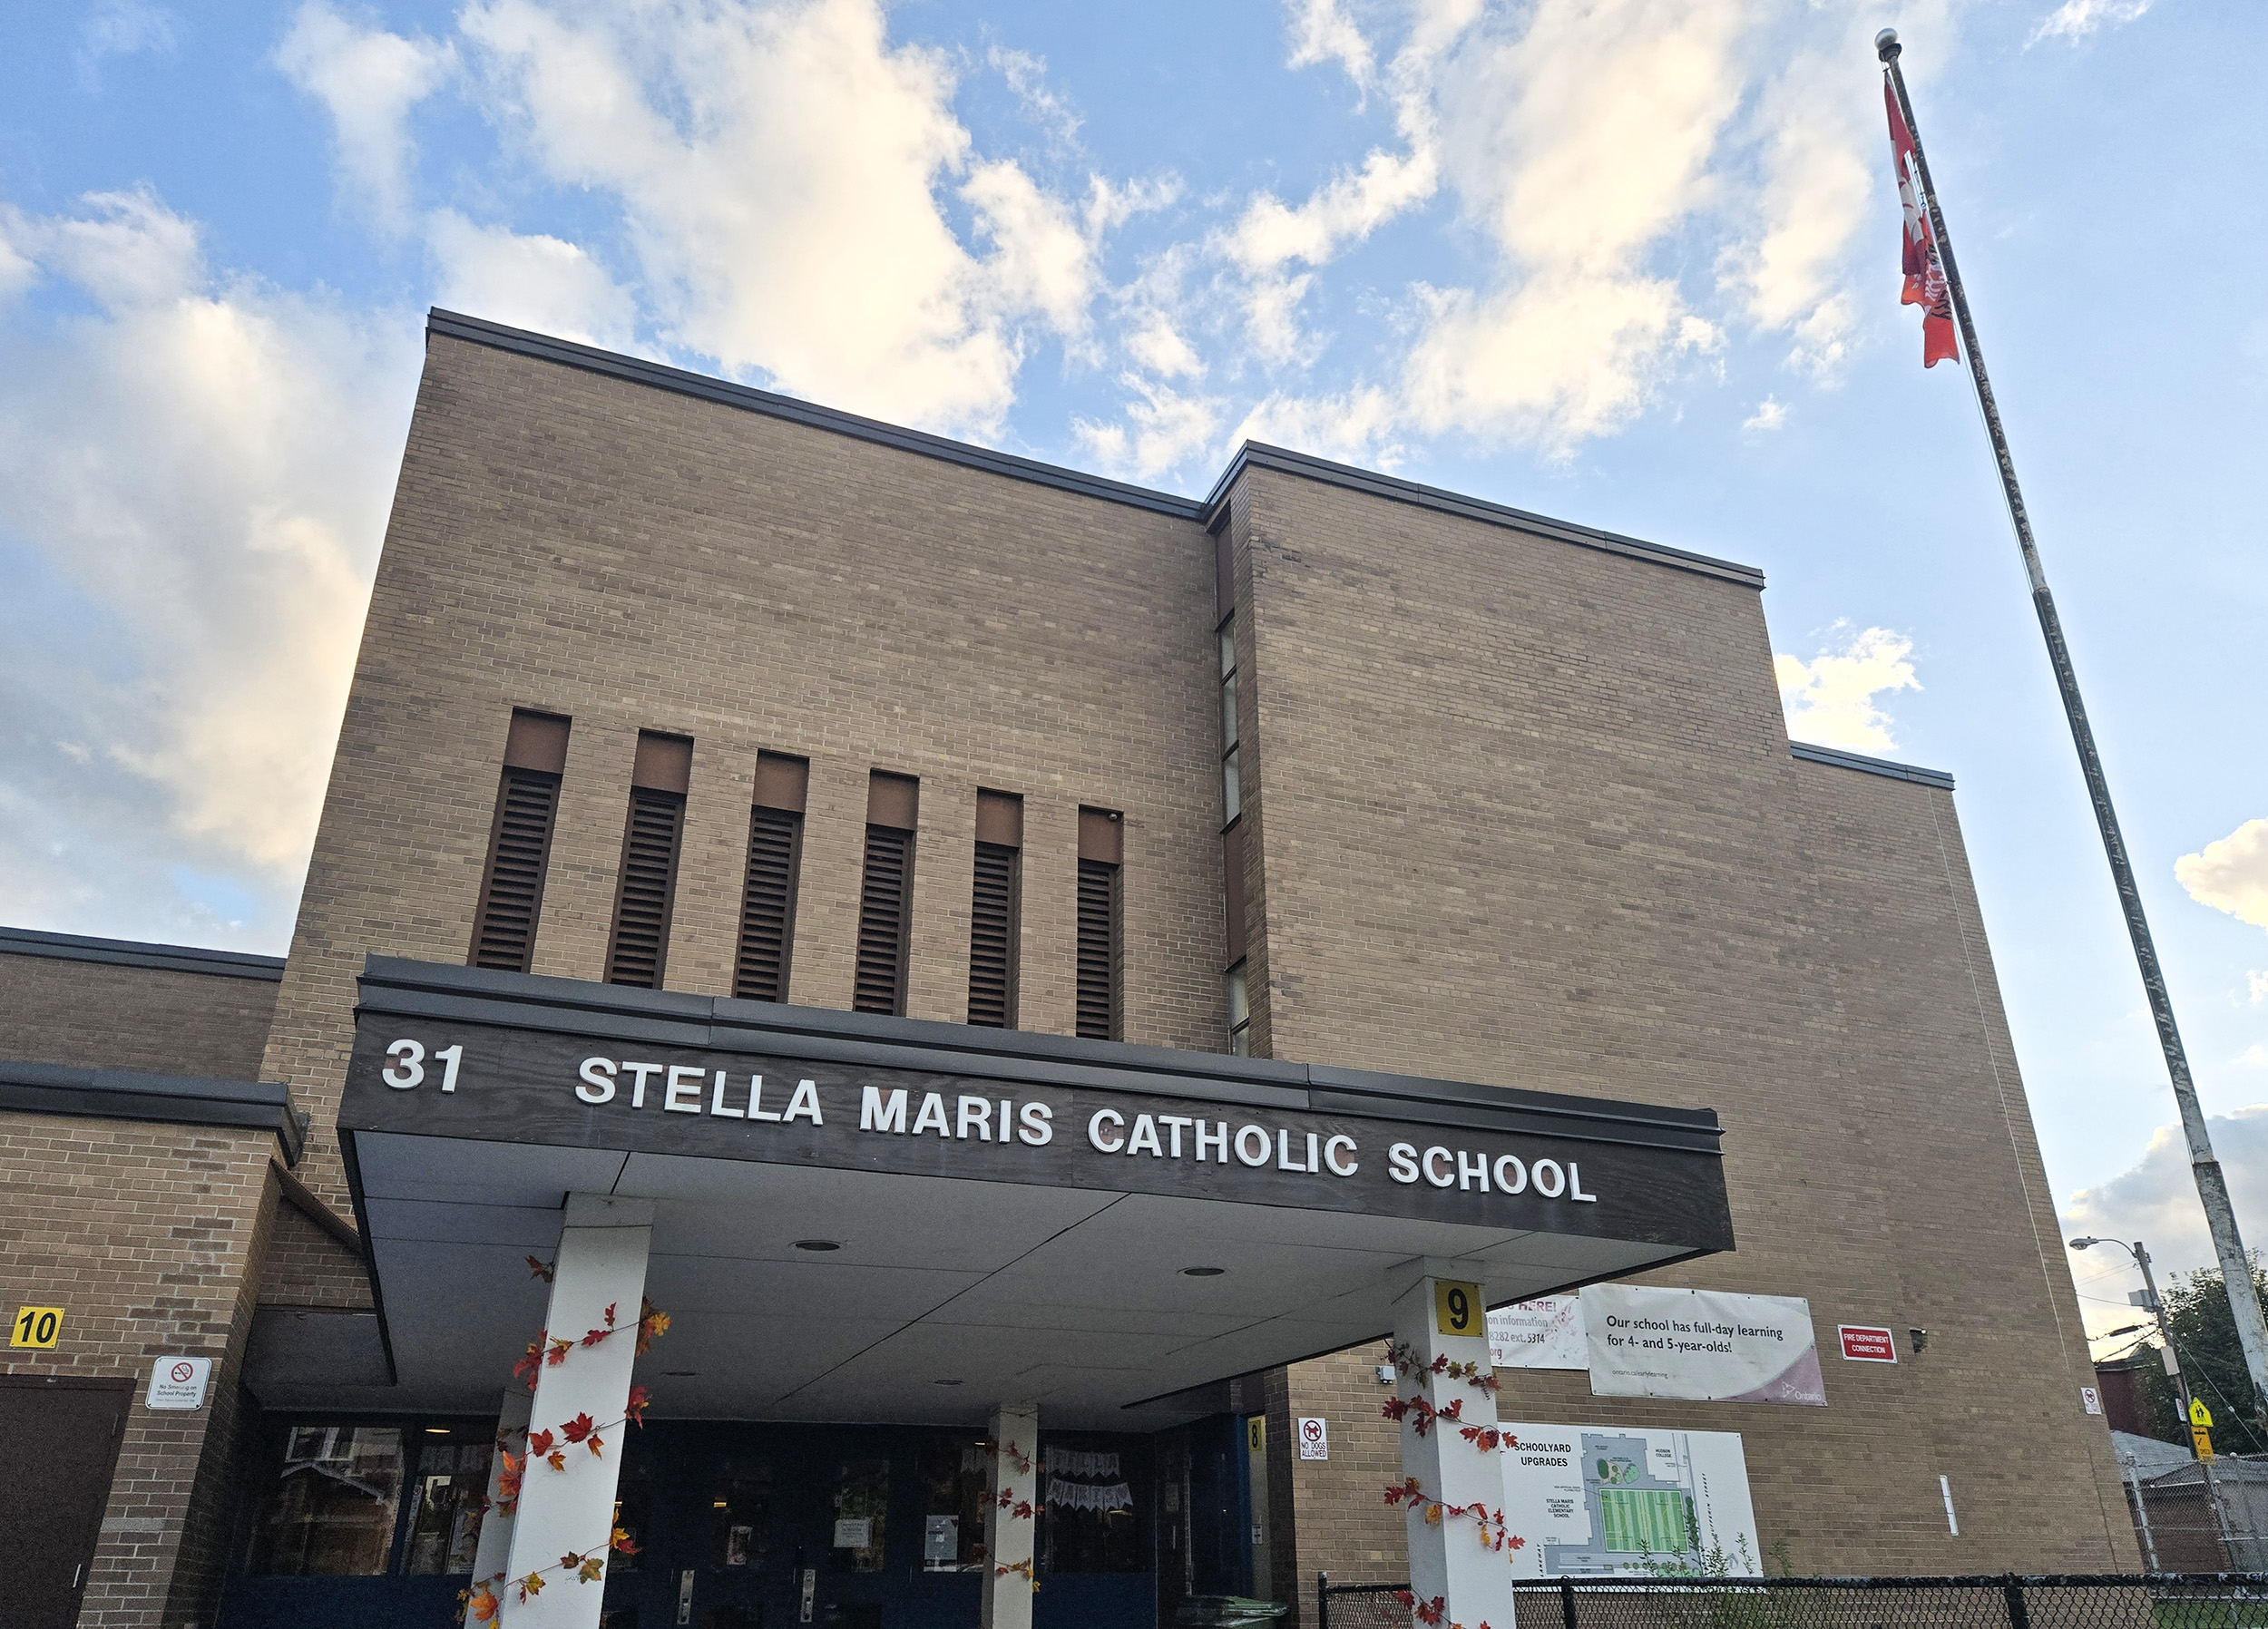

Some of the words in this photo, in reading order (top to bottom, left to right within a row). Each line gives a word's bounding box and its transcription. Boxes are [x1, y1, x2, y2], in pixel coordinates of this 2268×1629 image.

[382, 1039, 463, 1094] 31
[575, 1057, 823, 1126] STELLA
[859, 1086, 1053, 1146] MARIS
[1088, 1108, 1358, 1176] CATHOLIC
[1388, 1142, 1597, 1202] SCHOOL
[1448, 1289, 1468, 1330] 9
[20, 1312, 56, 1343] 10
[1500, 1314, 1548, 1328] information
[1607, 1315, 1629, 1328] Our
[1633, 1318, 1669, 1331] school
[1672, 1320, 1691, 1332] has
[1694, 1322, 1734, 1338] full-day
[1737, 1324, 1784, 1341] learning
[1510, 1333, 1526, 1342] ext.
[1528, 1333, 1545, 1343] 5314
[1608, 1334, 1624, 1346] for
[1628, 1335, 1639, 1347] 4-
[1643, 1338, 1664, 1349] and
[1667, 1338, 1732, 1353] 5-year-olds!
[1856, 1334, 1889, 1343] DEPARTMENT
[1852, 1344, 1886, 1353] CONNECTION
[1794, 1390, 1822, 1401] Ontario
[1252, 1425, 1257, 1449] 8
[1514, 1442, 1571, 1453] SCHOOLYARD
[1520, 1457, 1568, 1467] UPGRADES
